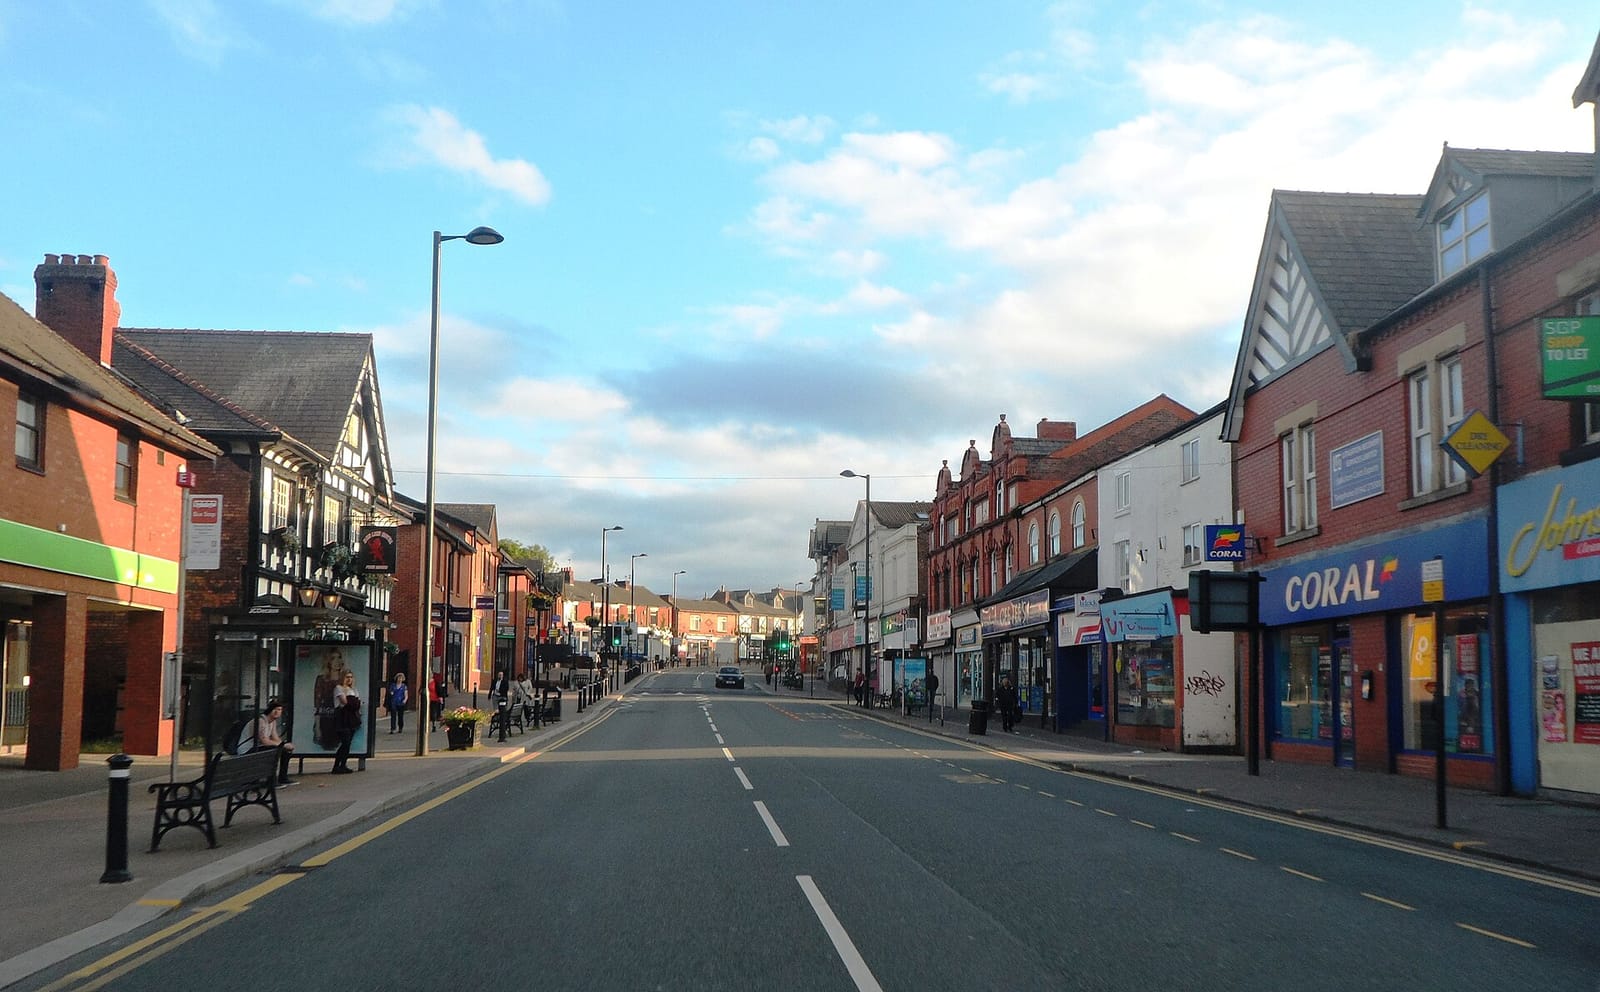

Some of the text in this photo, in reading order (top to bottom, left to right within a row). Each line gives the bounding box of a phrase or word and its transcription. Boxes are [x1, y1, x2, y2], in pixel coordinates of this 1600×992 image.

[1545, 321, 1581, 334] SGP
[1546, 348, 1589, 360] TO LET
[1456, 441, 1503, 450] CLEANING
[178, 473, 187, 483] E
[1210, 550, 1244, 558] CORAL
[1285, 559, 1381, 613] CORAL
